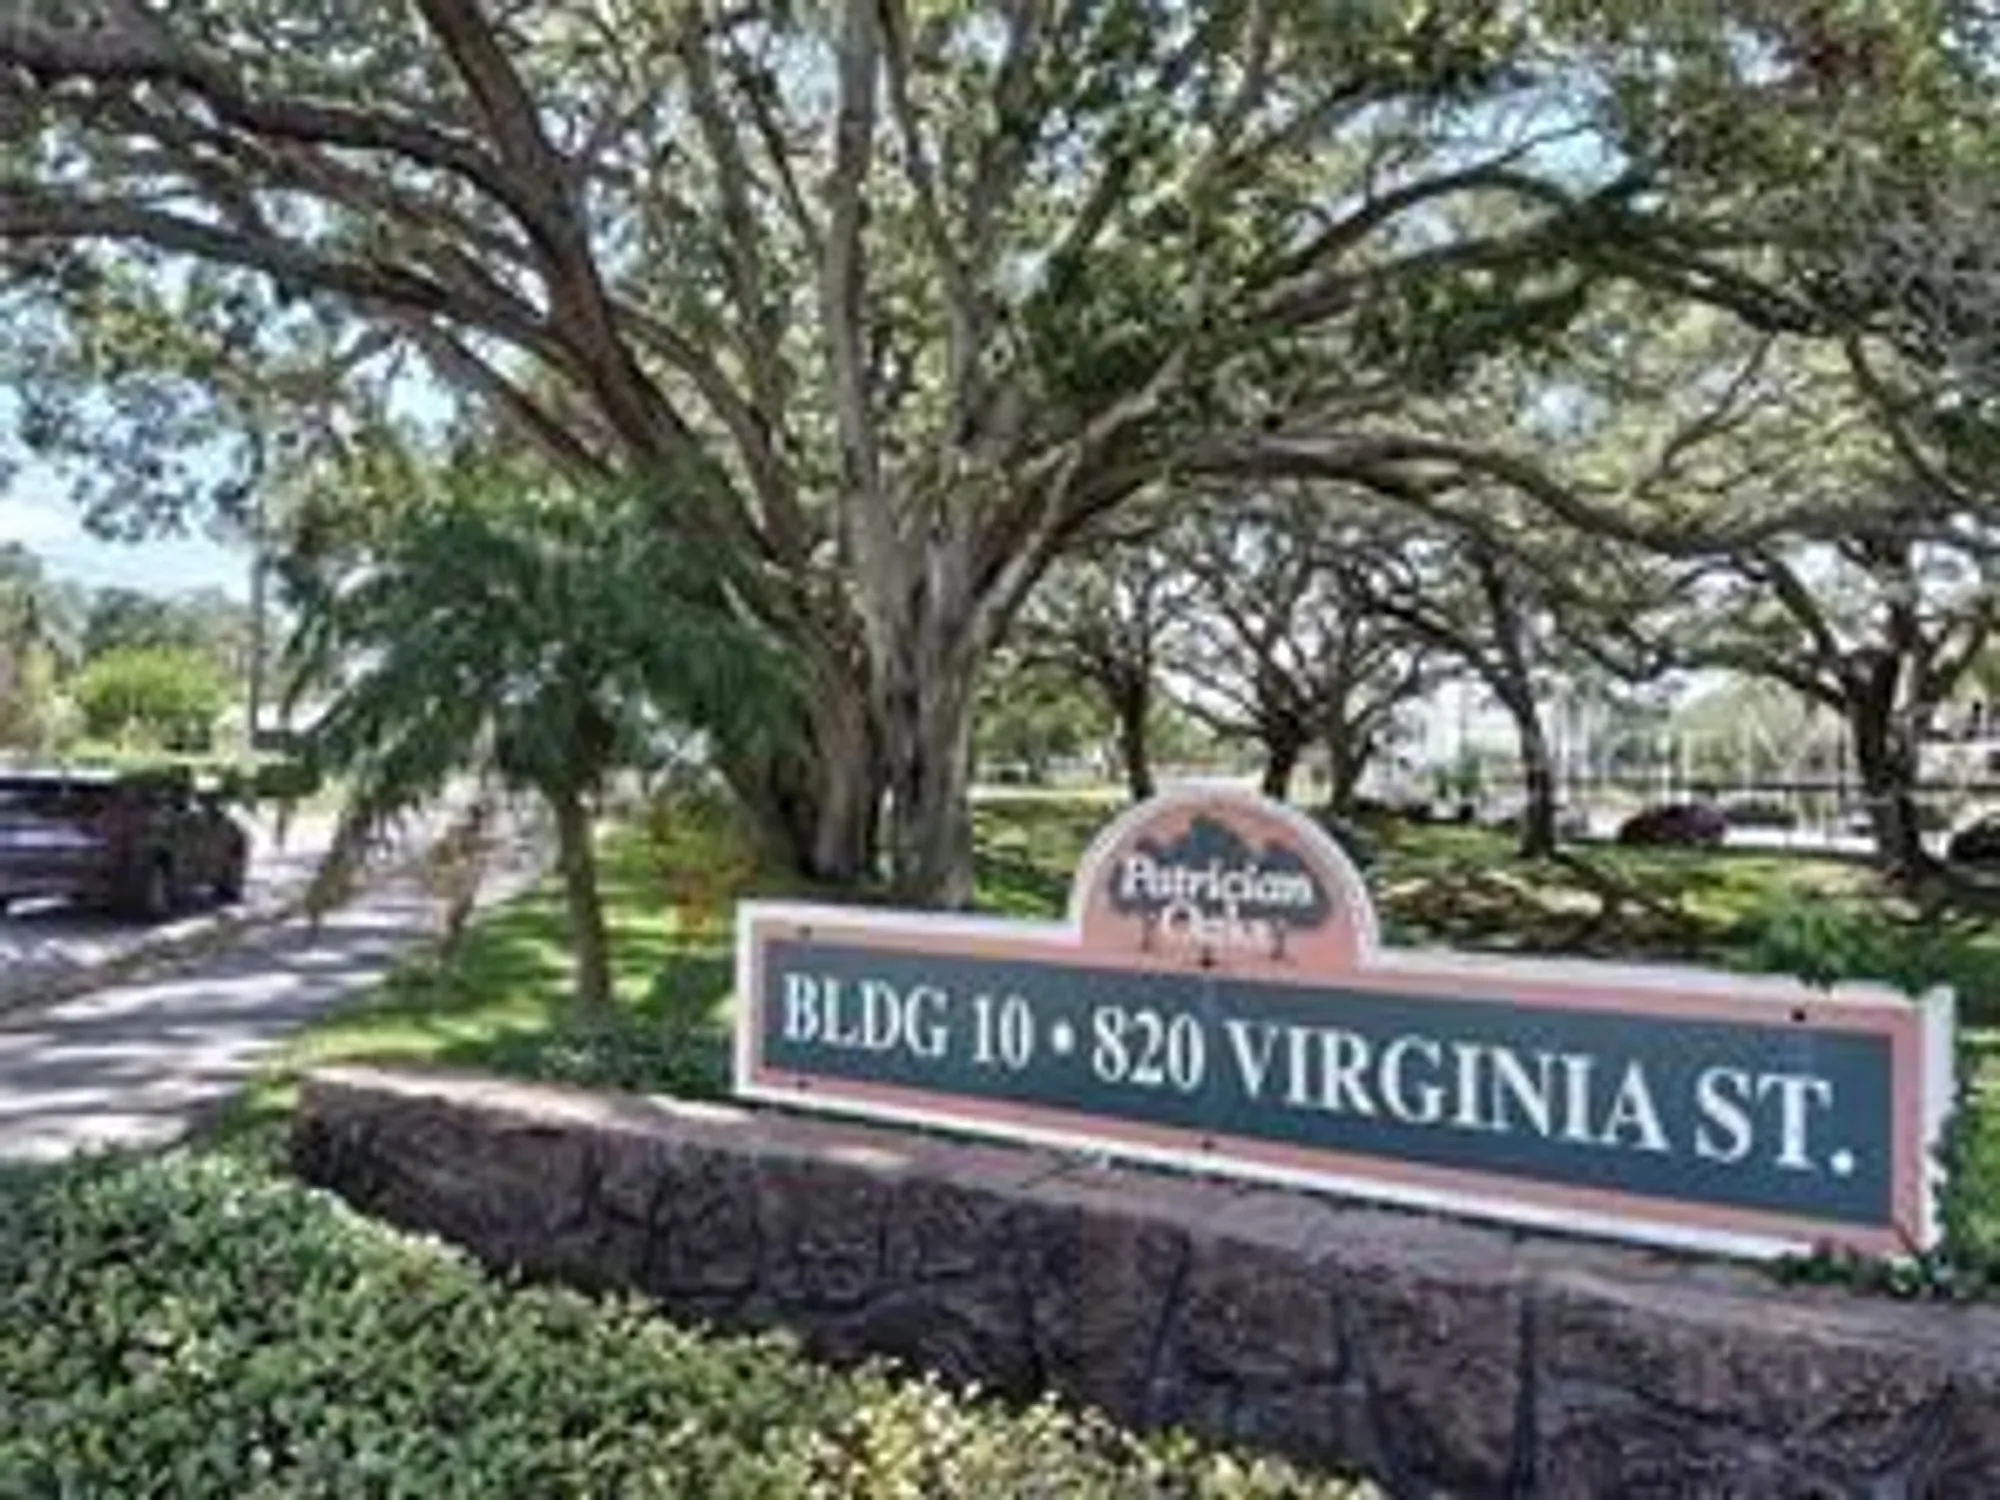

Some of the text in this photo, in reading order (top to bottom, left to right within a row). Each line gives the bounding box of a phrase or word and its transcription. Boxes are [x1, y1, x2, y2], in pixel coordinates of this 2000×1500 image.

[783, 972, 1855, 1176] BLDG 10 820 VIRGINIA ST.
